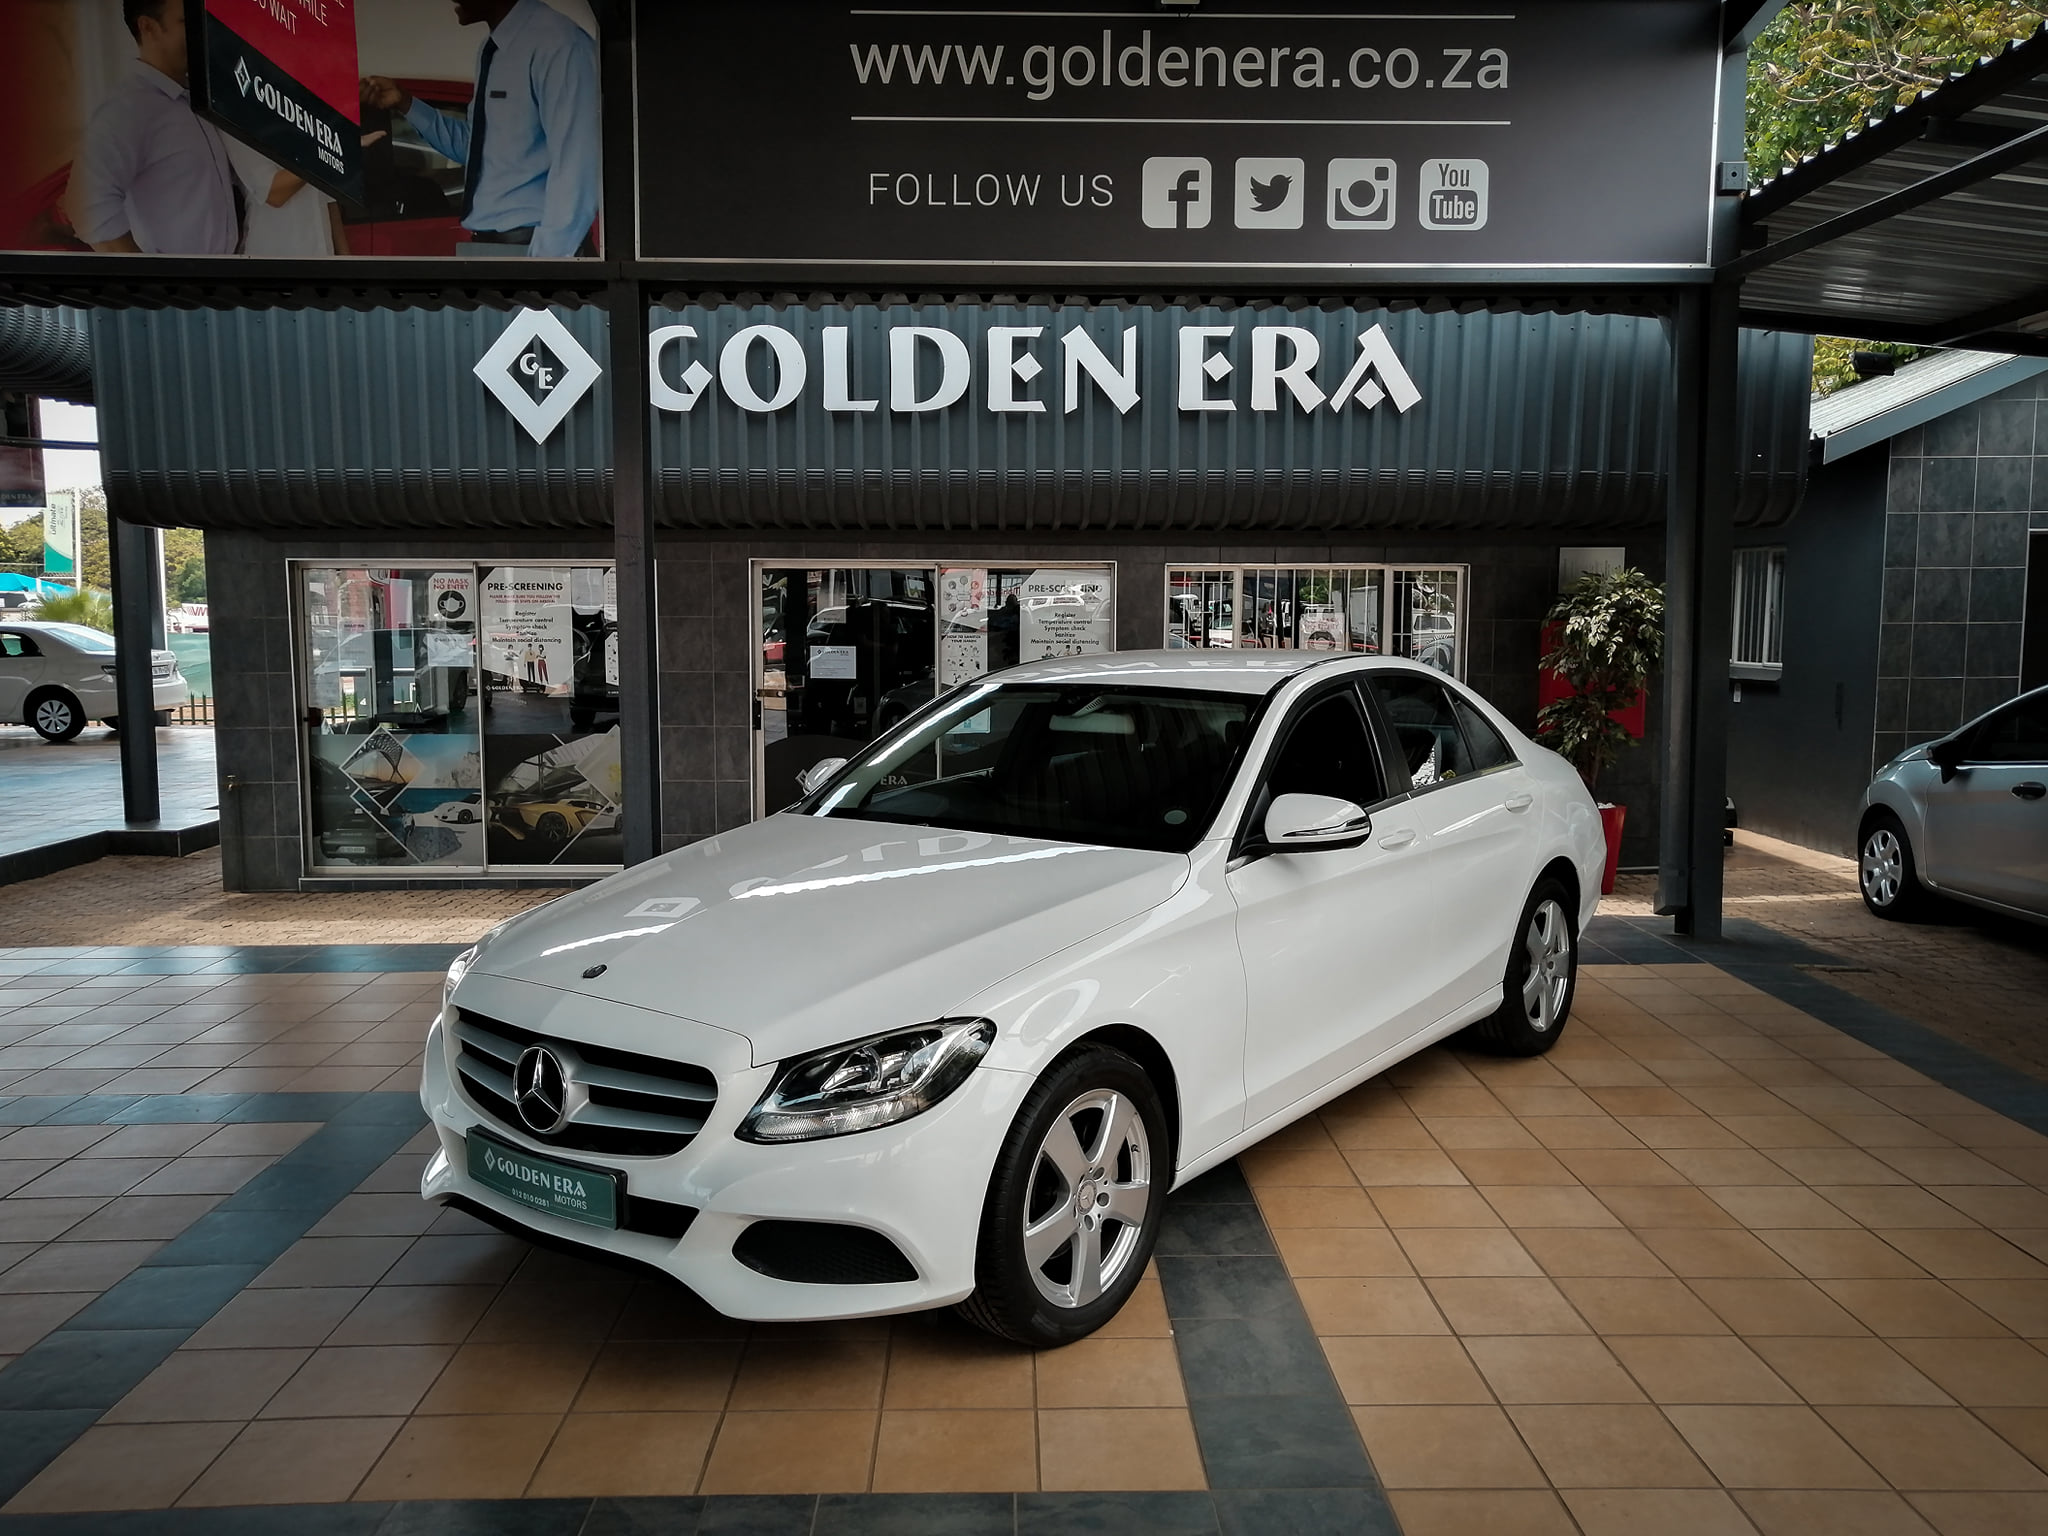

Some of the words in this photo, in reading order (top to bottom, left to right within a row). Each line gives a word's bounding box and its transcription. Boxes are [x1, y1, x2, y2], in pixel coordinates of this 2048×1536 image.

[850, 29, 1511, 101] www.goldenera.co.za
[253, 75, 314, 138] GOLDEN
[315, 118, 344, 157] ERA
[317, 146, 345, 175] MOTORS
[869, 173, 1043, 207] FOLLOW
[1060, 173, 1115, 207] US
[1437, 163, 1471, 189] You
[1432, 194, 1476, 222] Tube
[649, 324, 1141, 414] GOLDEN
[1178, 323, 1423, 414] ERA
[487, 582, 564, 591] PRE-SCREENING
[880, 775, 908, 785] ERA
[496, 1156, 551, 1188] GOLDEN
[553, 1175, 587, 1198] ERA
[553, 1194, 588, 1210] MOTORS
